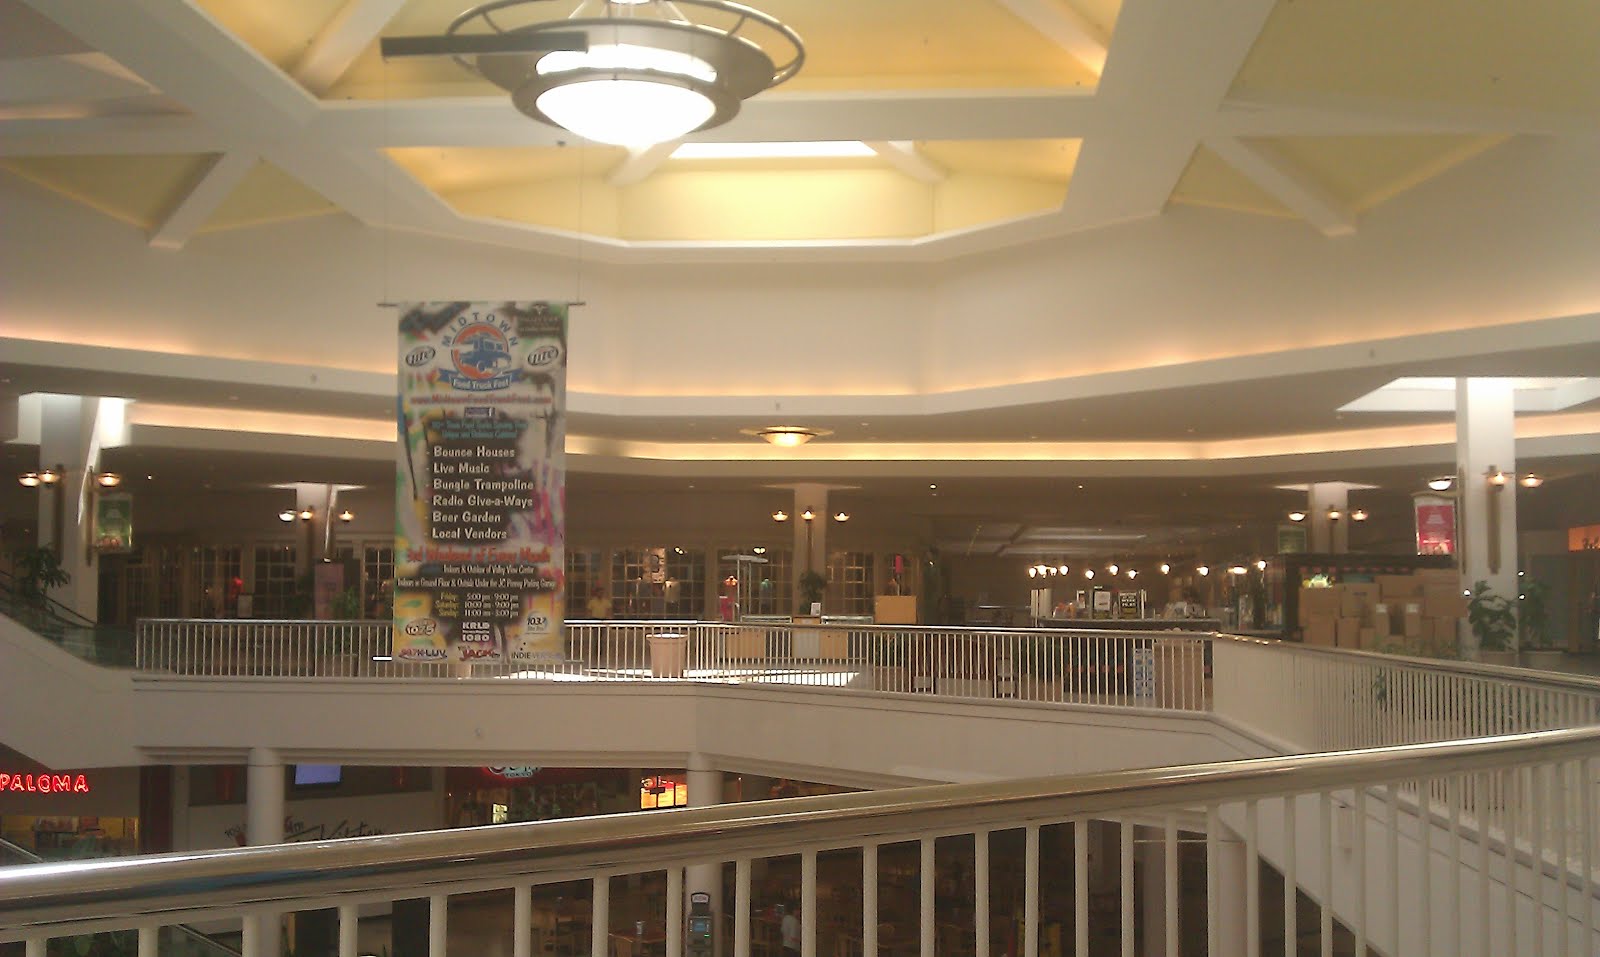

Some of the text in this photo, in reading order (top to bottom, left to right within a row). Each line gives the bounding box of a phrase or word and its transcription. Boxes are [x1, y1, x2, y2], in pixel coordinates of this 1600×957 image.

[441, 312, 519, 347] MIDTOWN
[433, 445, 515, 458] Bounce Houses
[433, 462, 490, 474] Live Music
[474, 478, 534, 492] Trampoline
[433, 495, 533, 509] Radio Give-a-Ways
[432, 511, 501, 523] Beer Garden
[432, 528, 507, 540] Local Vendors
[462, 621, 490, 629] KRLD
[462, 633, 490, 642] 1080
[0, 773, 89, 793] PALOMA
